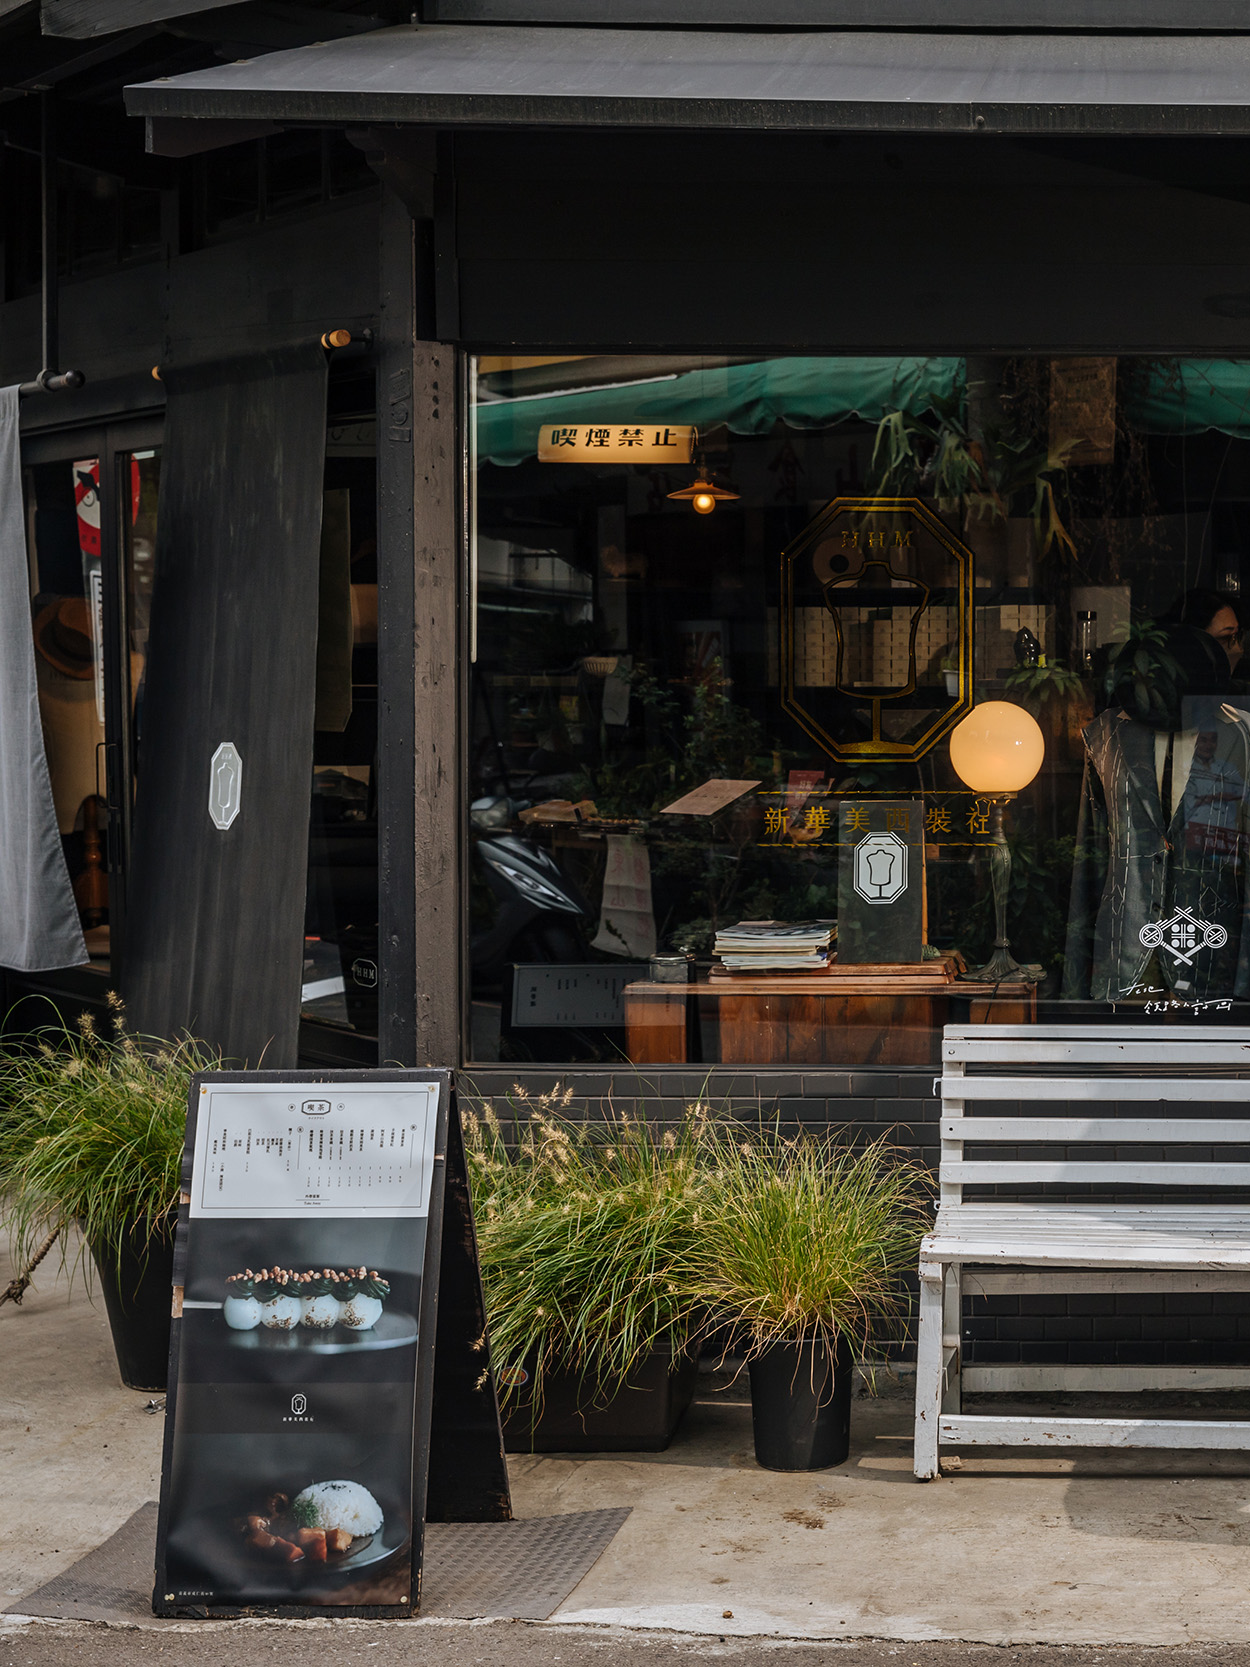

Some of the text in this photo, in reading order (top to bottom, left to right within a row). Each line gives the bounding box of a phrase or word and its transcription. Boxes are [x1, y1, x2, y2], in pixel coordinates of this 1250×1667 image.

[551, 428, 677, 447] 喫煙禁止
[841, 530, 914, 549] HHM
[764, 797, 990, 835] 新華美西裝社
[356, 966, 375, 980] HHM
[307, 1103, 325, 1111] 喫茶
